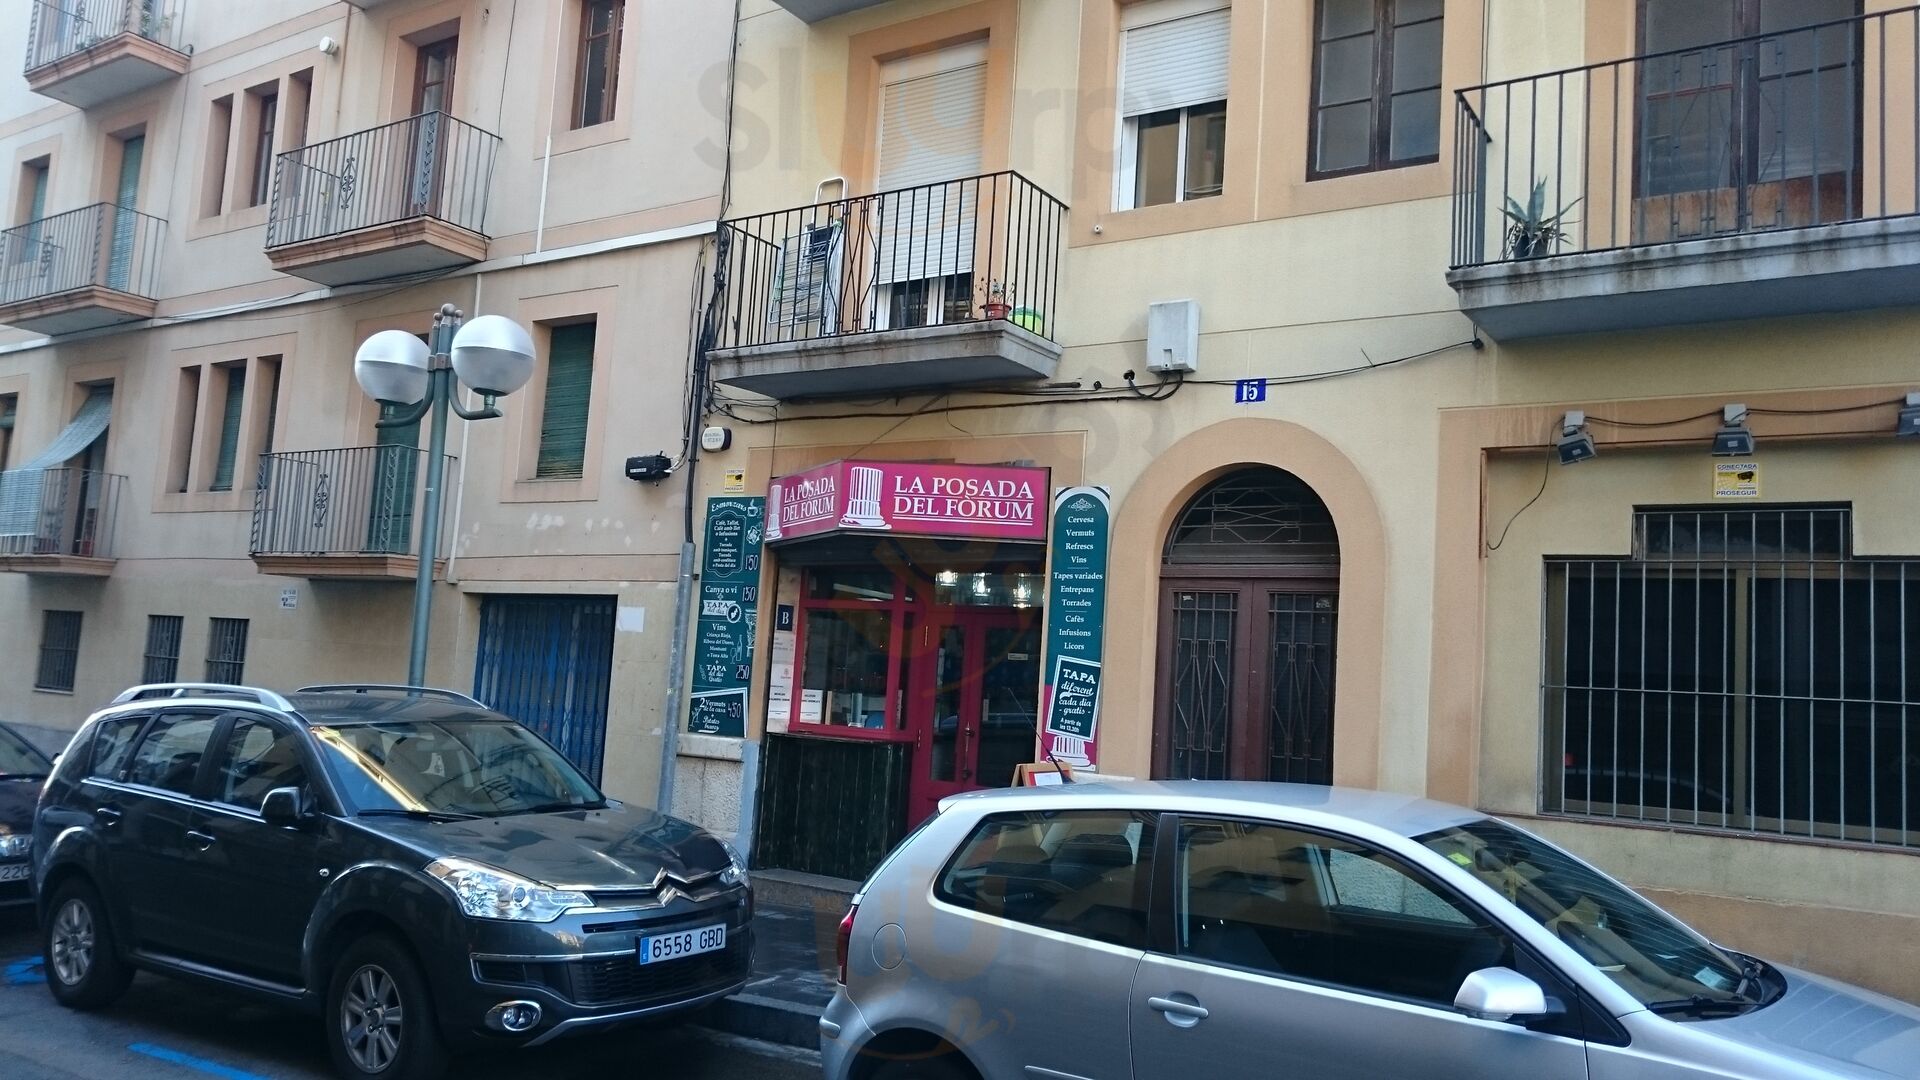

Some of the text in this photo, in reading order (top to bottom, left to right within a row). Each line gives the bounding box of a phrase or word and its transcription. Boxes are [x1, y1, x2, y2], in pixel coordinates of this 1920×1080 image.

[1242, 381, 1258, 401] 15
[784, 476, 835, 503] LA POSADA
[894, 475, 1034, 499] LA POSADA
[711, 500, 747, 512] Esmorzars
[894, 497, 939, 515] DEL
[783, 504, 799, 522] DEL
[1054, 572, 1074, 580] Tapes
[705, 586, 724, 596] Canya
[1060, 586, 1094, 594] Entrepans
[782, 611, 789, 624] B
[712, 623, 726, 632] Vins
[1059, 628, 1092, 636] Infusions
[1062, 668, 1096, 684] TAPA
[1060, 680, 1094, 696] diferent
[700, 698, 706, 708] 2
[1058, 697, 1092, 707] cada dia
[1063, 707, 1086, 716] gratis
[653, 928, 723, 958] 6558 GBD
